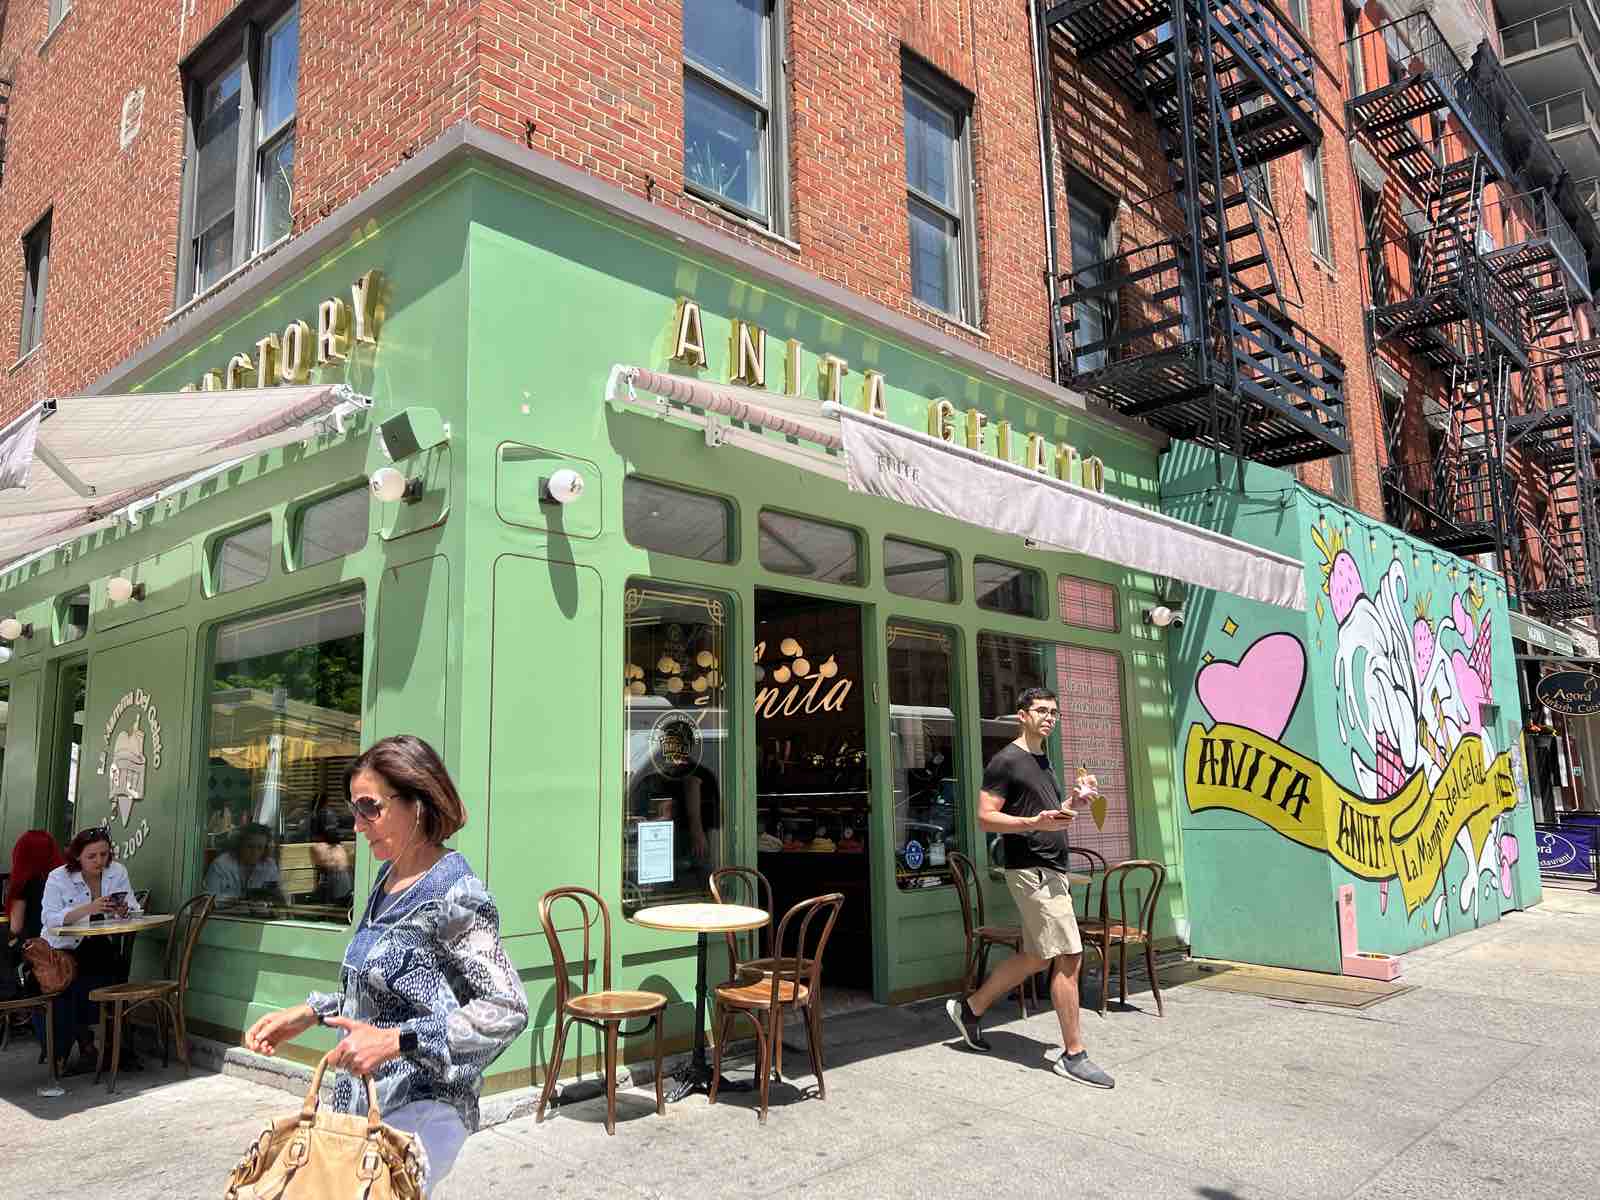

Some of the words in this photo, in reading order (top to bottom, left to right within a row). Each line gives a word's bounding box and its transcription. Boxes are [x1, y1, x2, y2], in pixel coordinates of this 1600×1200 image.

[180, 269, 384, 392] CTORY
[671, 297, 888, 418] ANITA
[928, 399, 1104, 494] GELATO
[753, 641, 852, 719] nita
[1197, 737, 1313, 823] ANITA
[123, 818, 152, 859] 2002
[1336, 797, 1388, 870] ANITA
[1401, 848, 1419, 883] La
[1416, 810, 1450, 876] Mamma
[1445, 767, 1461, 818] del
